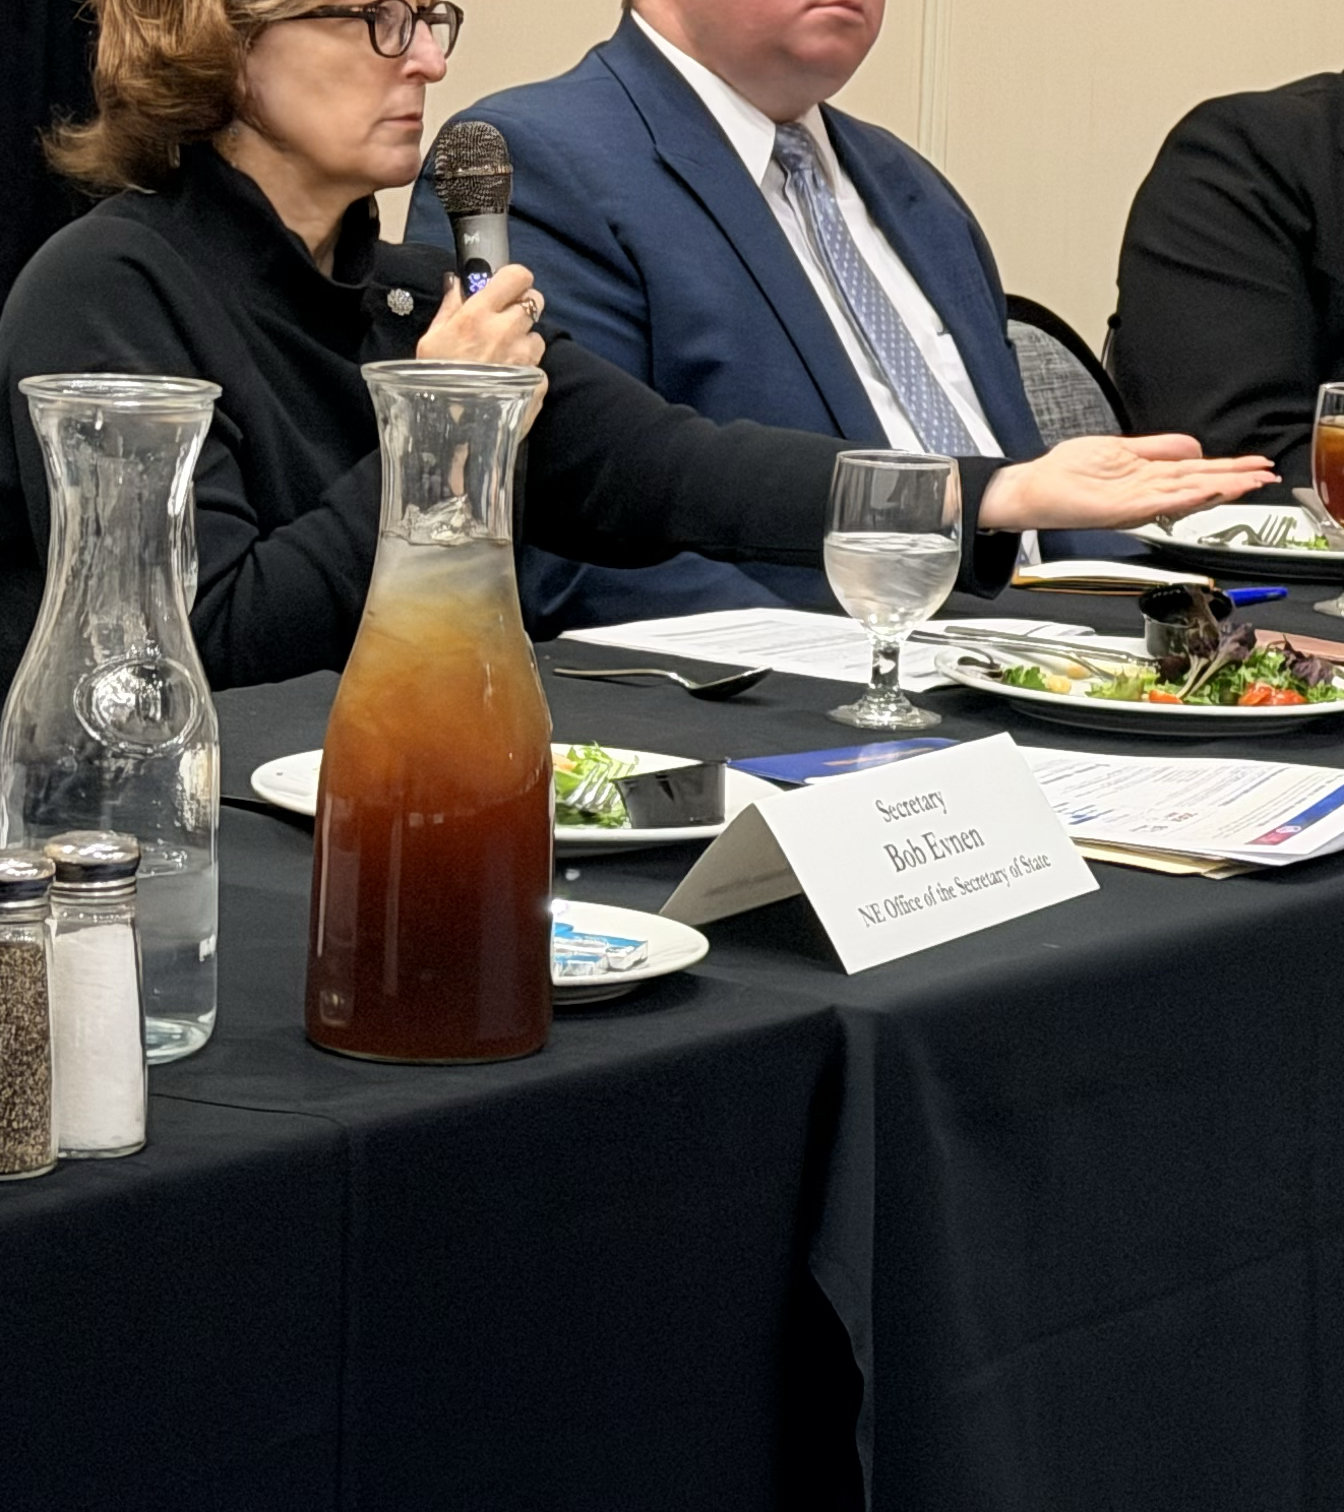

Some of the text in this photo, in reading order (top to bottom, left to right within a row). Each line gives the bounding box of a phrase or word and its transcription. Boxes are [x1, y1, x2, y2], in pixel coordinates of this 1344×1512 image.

[874, 790, 949, 823] Secretary
[882, 826, 986, 873] Bob Evnen
[856, 853, 1052, 928] NE Office of the Secretary of State
